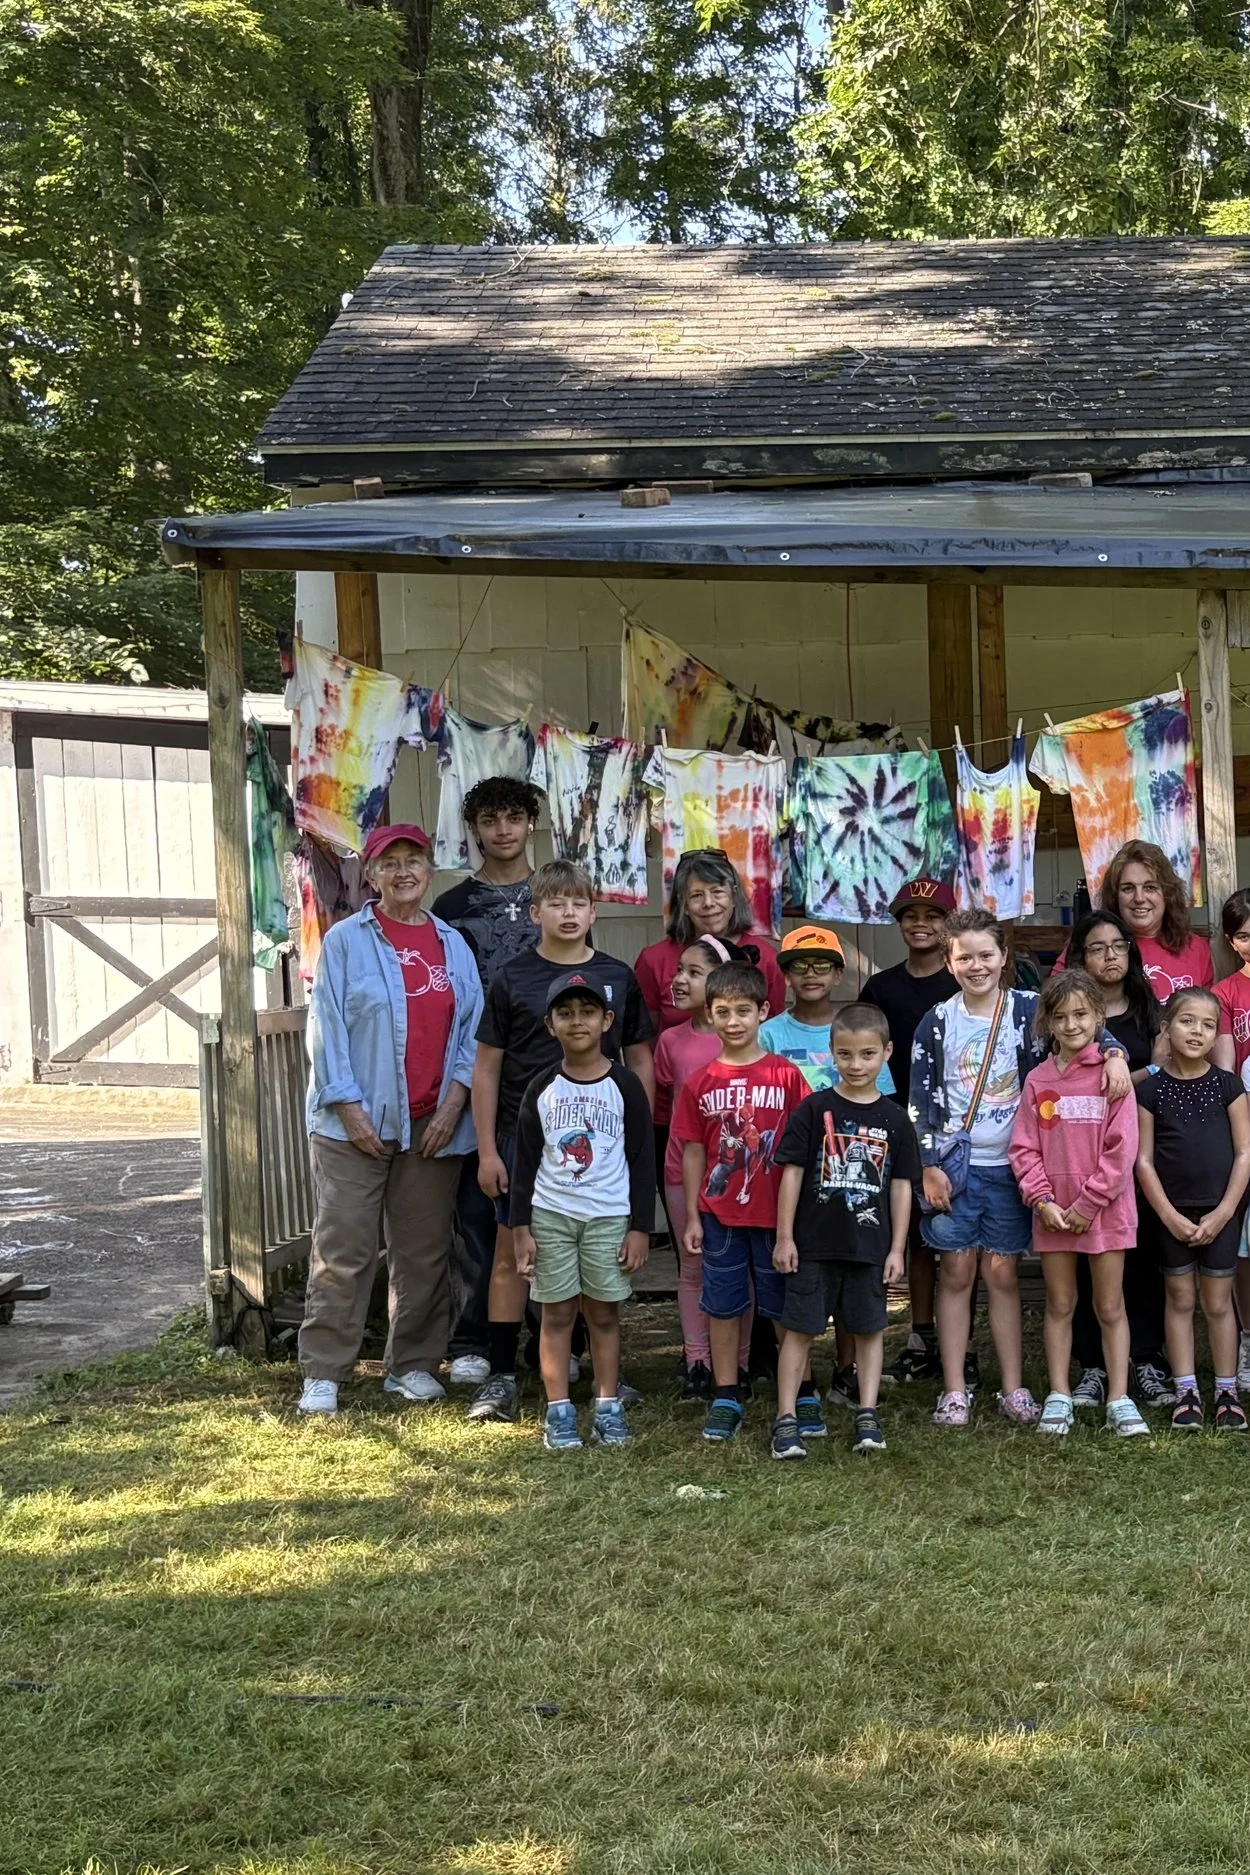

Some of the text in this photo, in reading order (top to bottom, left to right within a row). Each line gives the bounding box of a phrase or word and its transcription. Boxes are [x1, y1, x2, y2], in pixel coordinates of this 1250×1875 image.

[556, 1096, 569, 1106] THE
[823, 1180, 880, 1193] DARTH VADER
